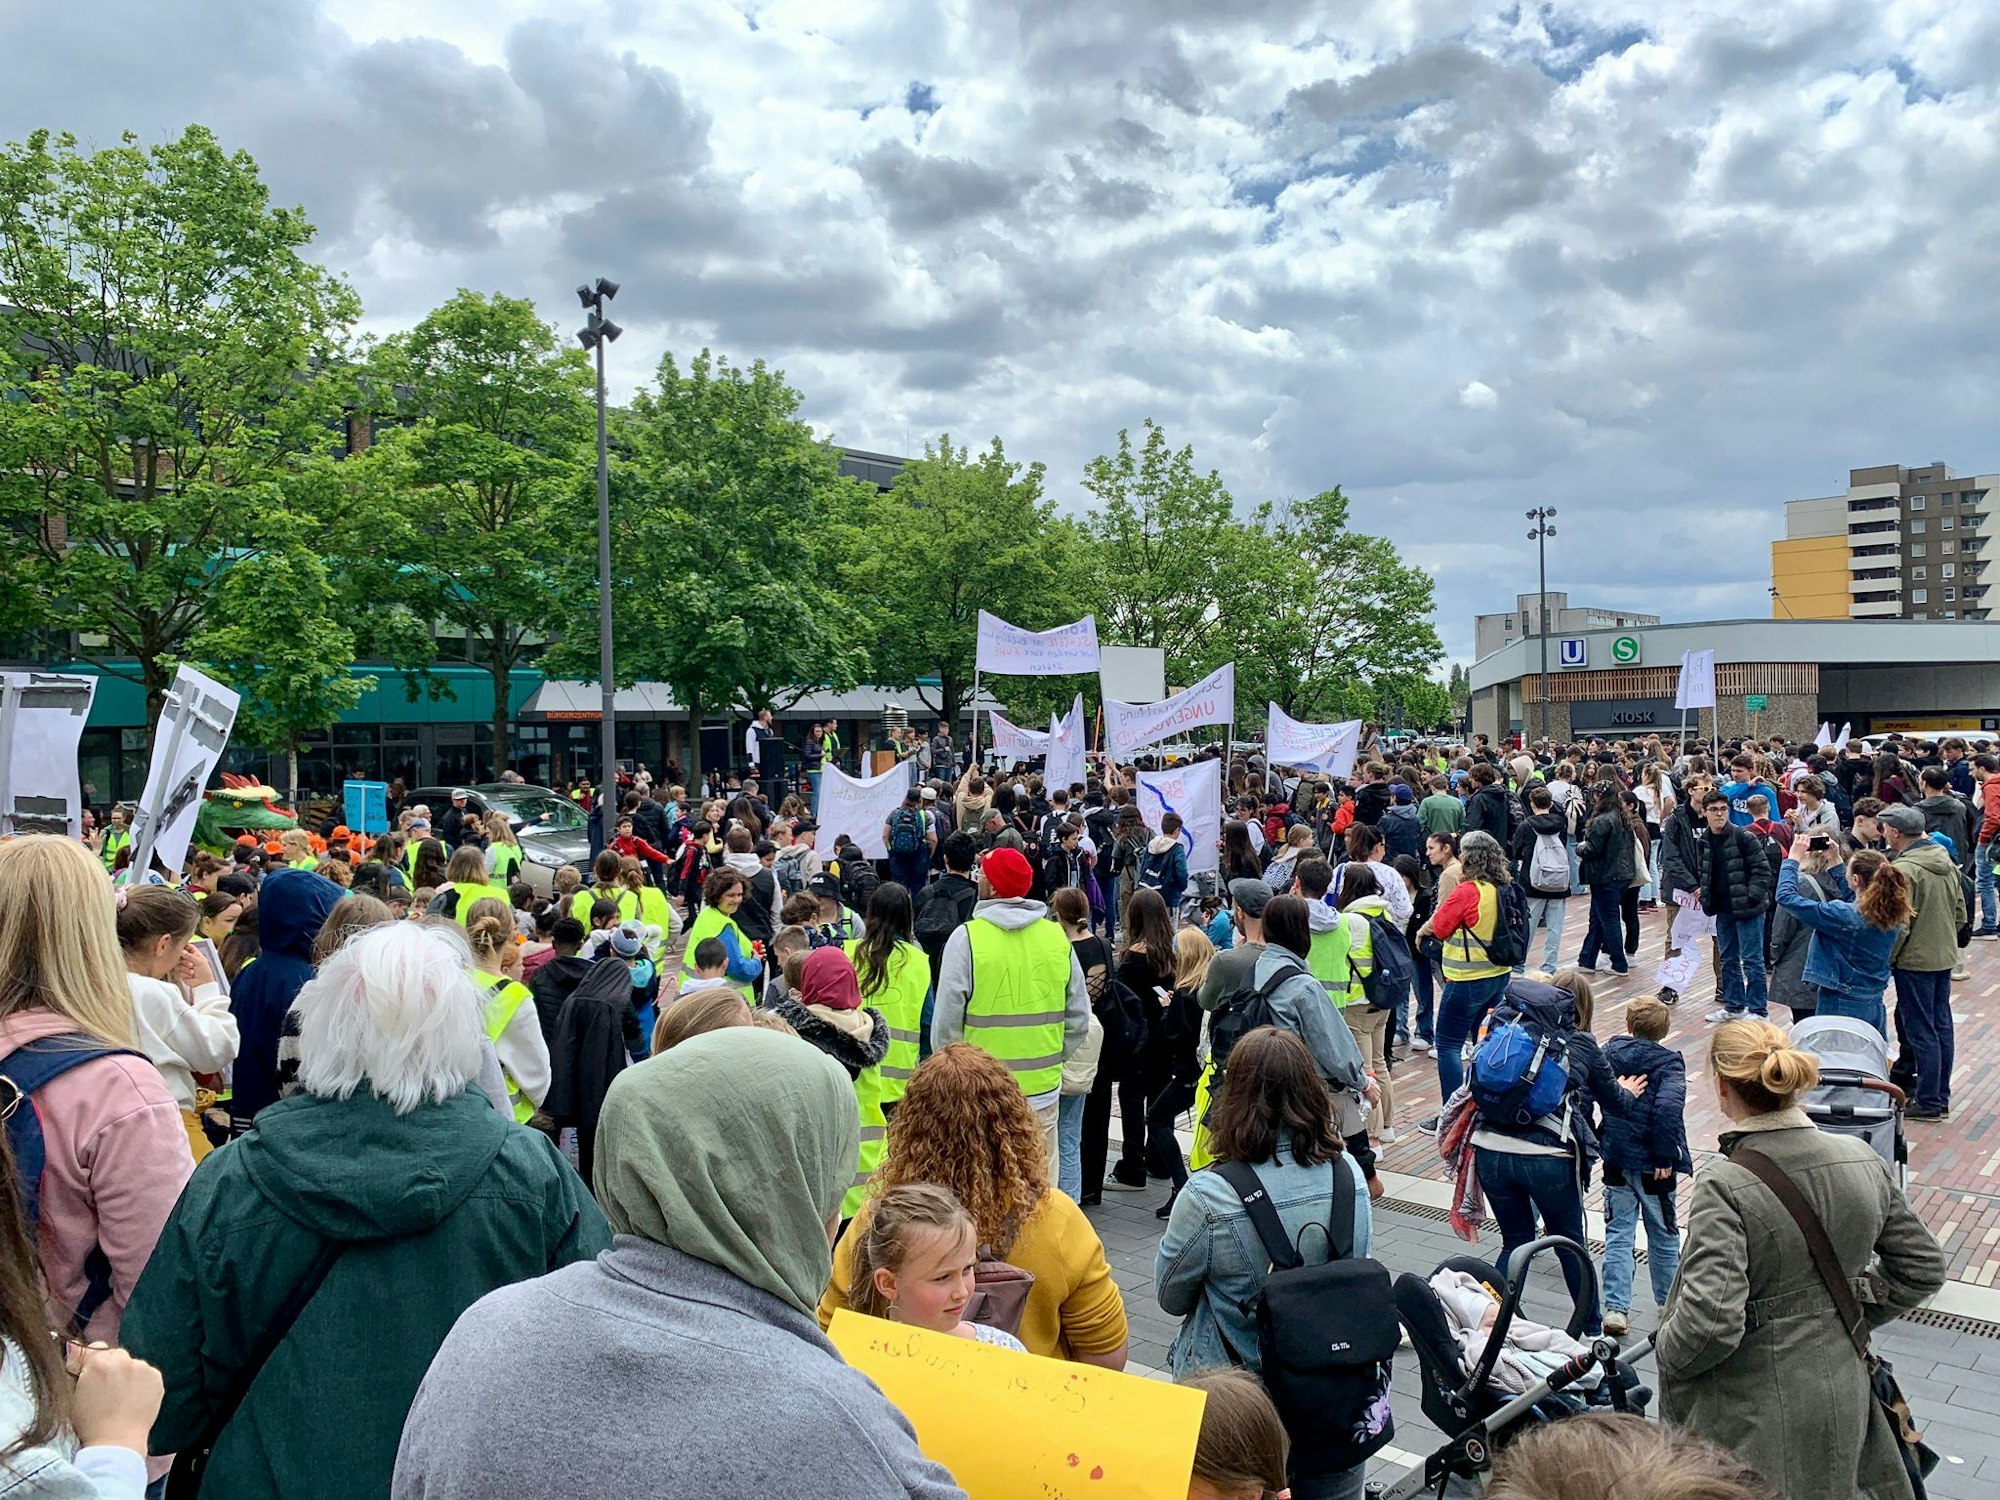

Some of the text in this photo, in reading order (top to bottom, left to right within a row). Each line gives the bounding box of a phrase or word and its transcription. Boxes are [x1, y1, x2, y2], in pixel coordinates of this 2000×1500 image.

[1562, 641, 1583, 663] U
[1616, 639, 1634, 660] S
[1611, 711, 1654, 723] KIOSK
[990, 962, 1052, 1012] ALS
